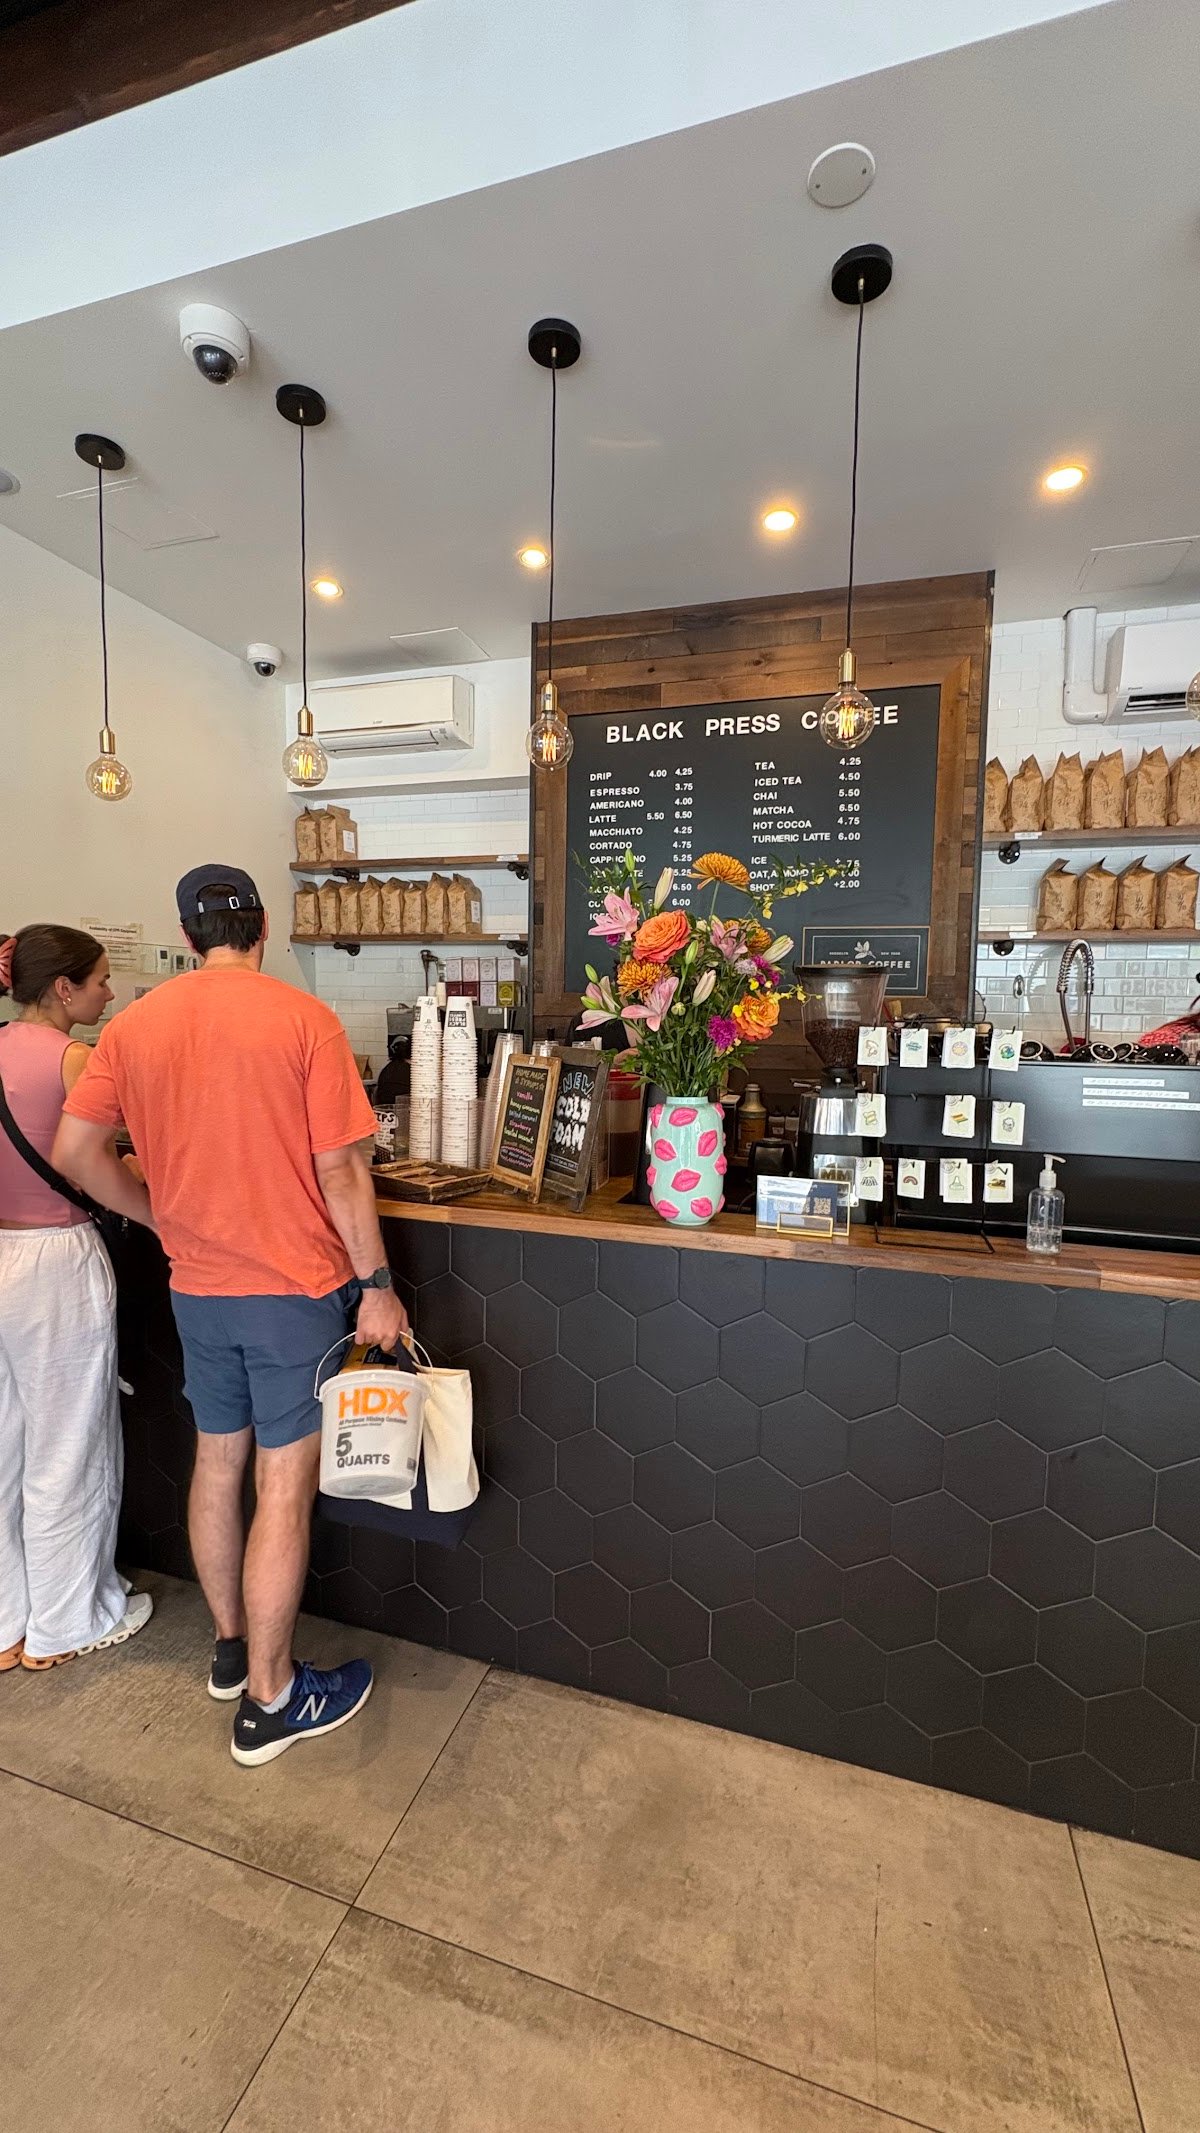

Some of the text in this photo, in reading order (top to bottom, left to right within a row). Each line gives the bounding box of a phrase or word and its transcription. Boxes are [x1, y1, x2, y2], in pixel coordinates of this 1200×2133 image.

[606, 704, 899, 744] BLACK PRESS COEE
[755, 757, 862, 770] TEA 4.25
[590, 767, 693, 781] DRIP 4.00 4.25
[755, 772, 861, 787] ICED TEA 4.50
[590, 783, 693, 797] ESPRESSO 3.75
[753, 788, 860, 801] CHAI 5.50
[590, 797, 693, 810] AMERICANO 4.00
[753, 803, 860, 815] MATCHA 6.50
[589, 811, 693, 824] LATTE 5.50 6.50
[753, 816, 860, 830] HOT COCOA 4.75
[589, 826, 693, 837] MACCHIATO 4.25
[752, 832, 861, 844] TURMERIC LATTE 6.00
[590, 841, 692, 850] CORTADO 4.75
[589, 854, 693, 864] CAPPUCNO 5.25
[751, 856, 767, 865] ICE
[672, 883, 692, 891] 6.50
[750, 880, 860, 892] SHOT +2.00
[671, 898, 691, 906] 6.00
[868, 960, 911, 969] COFFEE
[562, 1071, 595, 1095] NEW
[556, 1094, 592, 1123] COLD
[374, 1112, 395, 1123] IPS
[338, 1387, 410, 1418] HDX
[335, 1431, 352, 1457] 5
[337, 1454, 391, 1469] QUARTS
[296, 1694, 328, 1721] N
